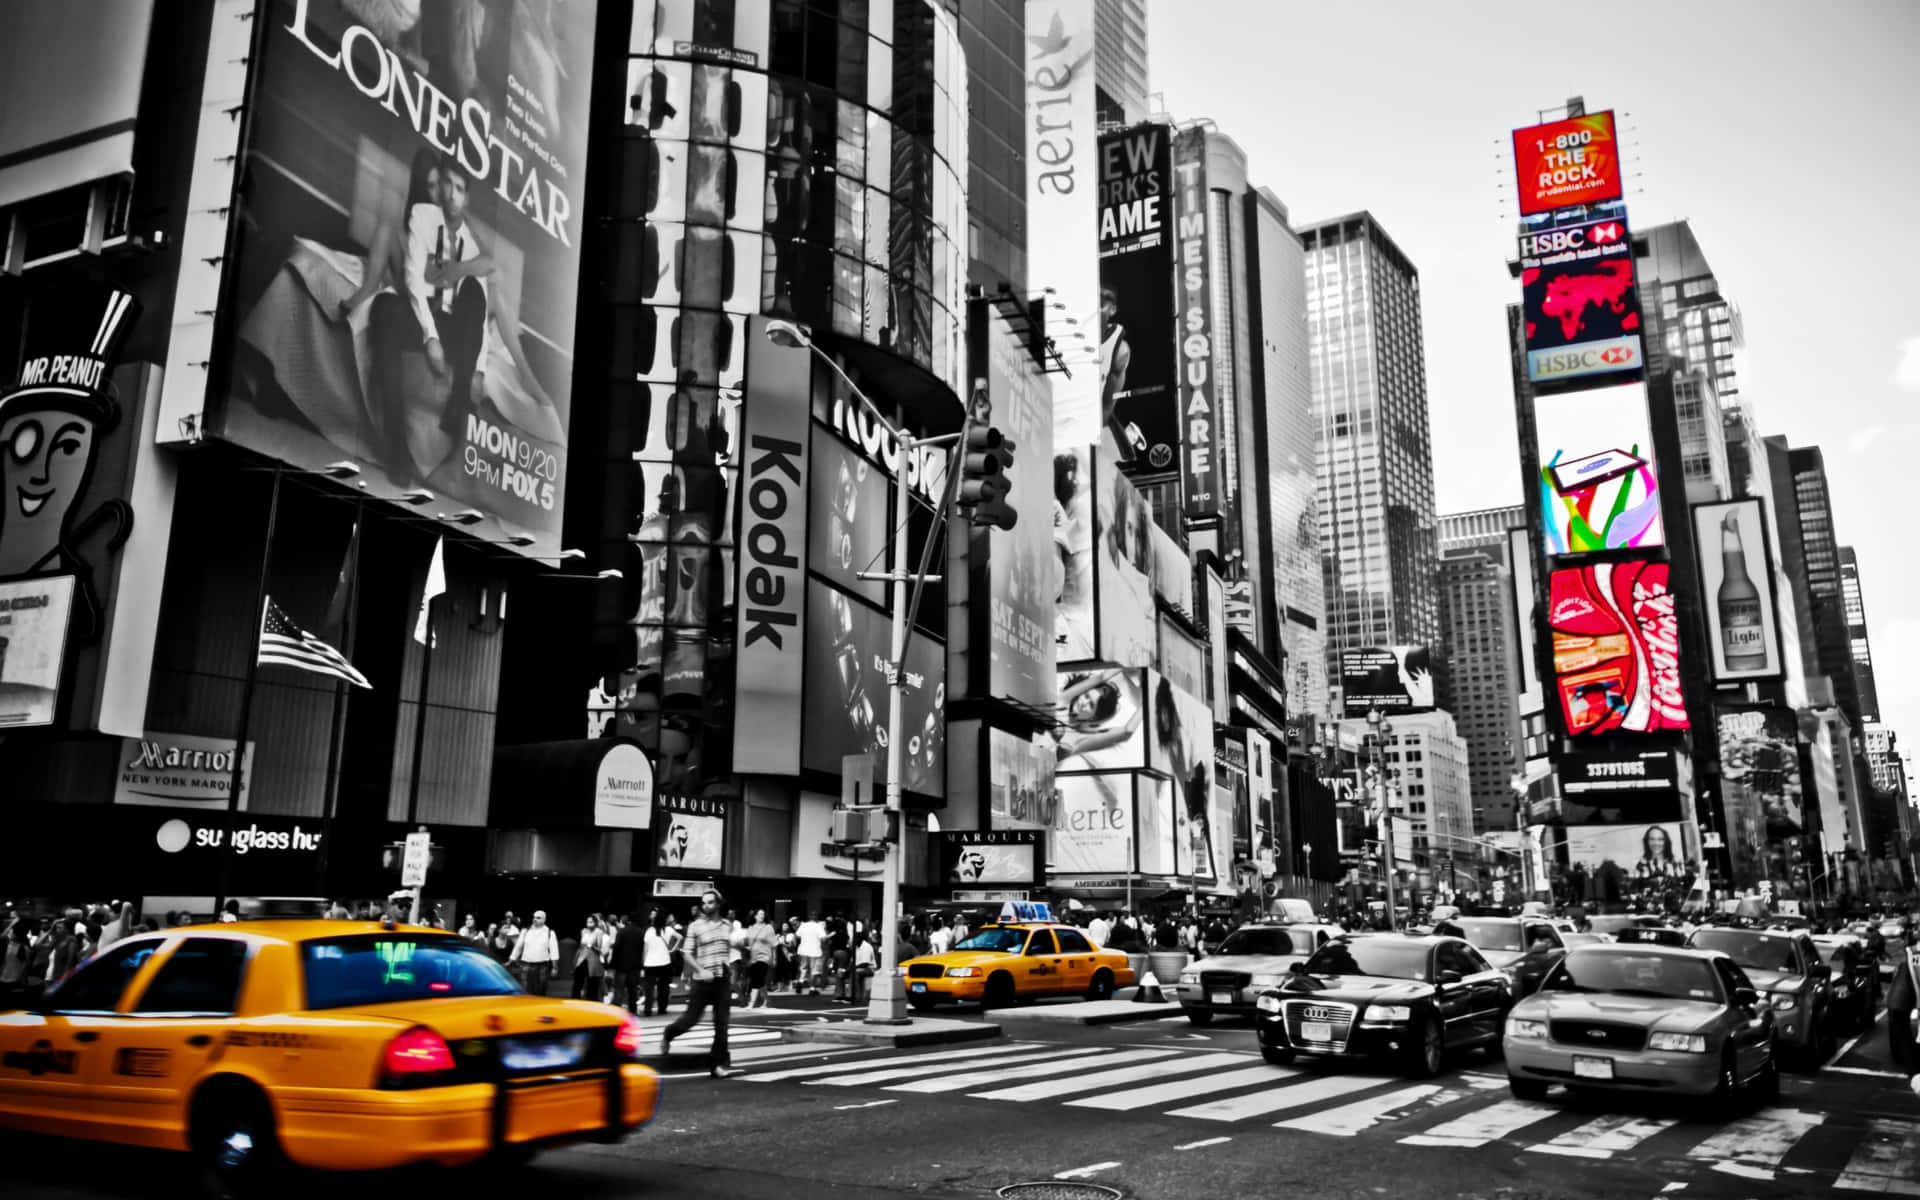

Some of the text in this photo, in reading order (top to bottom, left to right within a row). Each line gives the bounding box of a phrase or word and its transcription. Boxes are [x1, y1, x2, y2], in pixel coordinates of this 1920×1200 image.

[504, 115, 521, 139] The
[1033, 62, 1076, 196] aerie
[1536, 129, 1593, 153] 1-800
[1103, 131, 1158, 181] EW
[1544, 147, 1586, 169] THE
[1538, 163, 1597, 188] ROCK
[1536, 178, 1605, 199] prudential.com
[1100, 195, 1161, 241] AME
[1520, 228, 1585, 257] HSBC
[20, 355, 106, 391] MR. PEANUT
[1536, 350, 1598, 375] HSBC
[1184, 306, 1211, 475] SQUARE
[466, 413, 558, 482] MON 9/20
[744, 433, 802, 651] Kodak
[129, 741, 246, 775] Marriot
[121, 773, 246, 792] NEW YORK MARQUS
[602, 776, 646, 792] Marriott
[659, 794, 726, 815] MARQUIS
[946, 831, 1036, 843] MARQUIS
